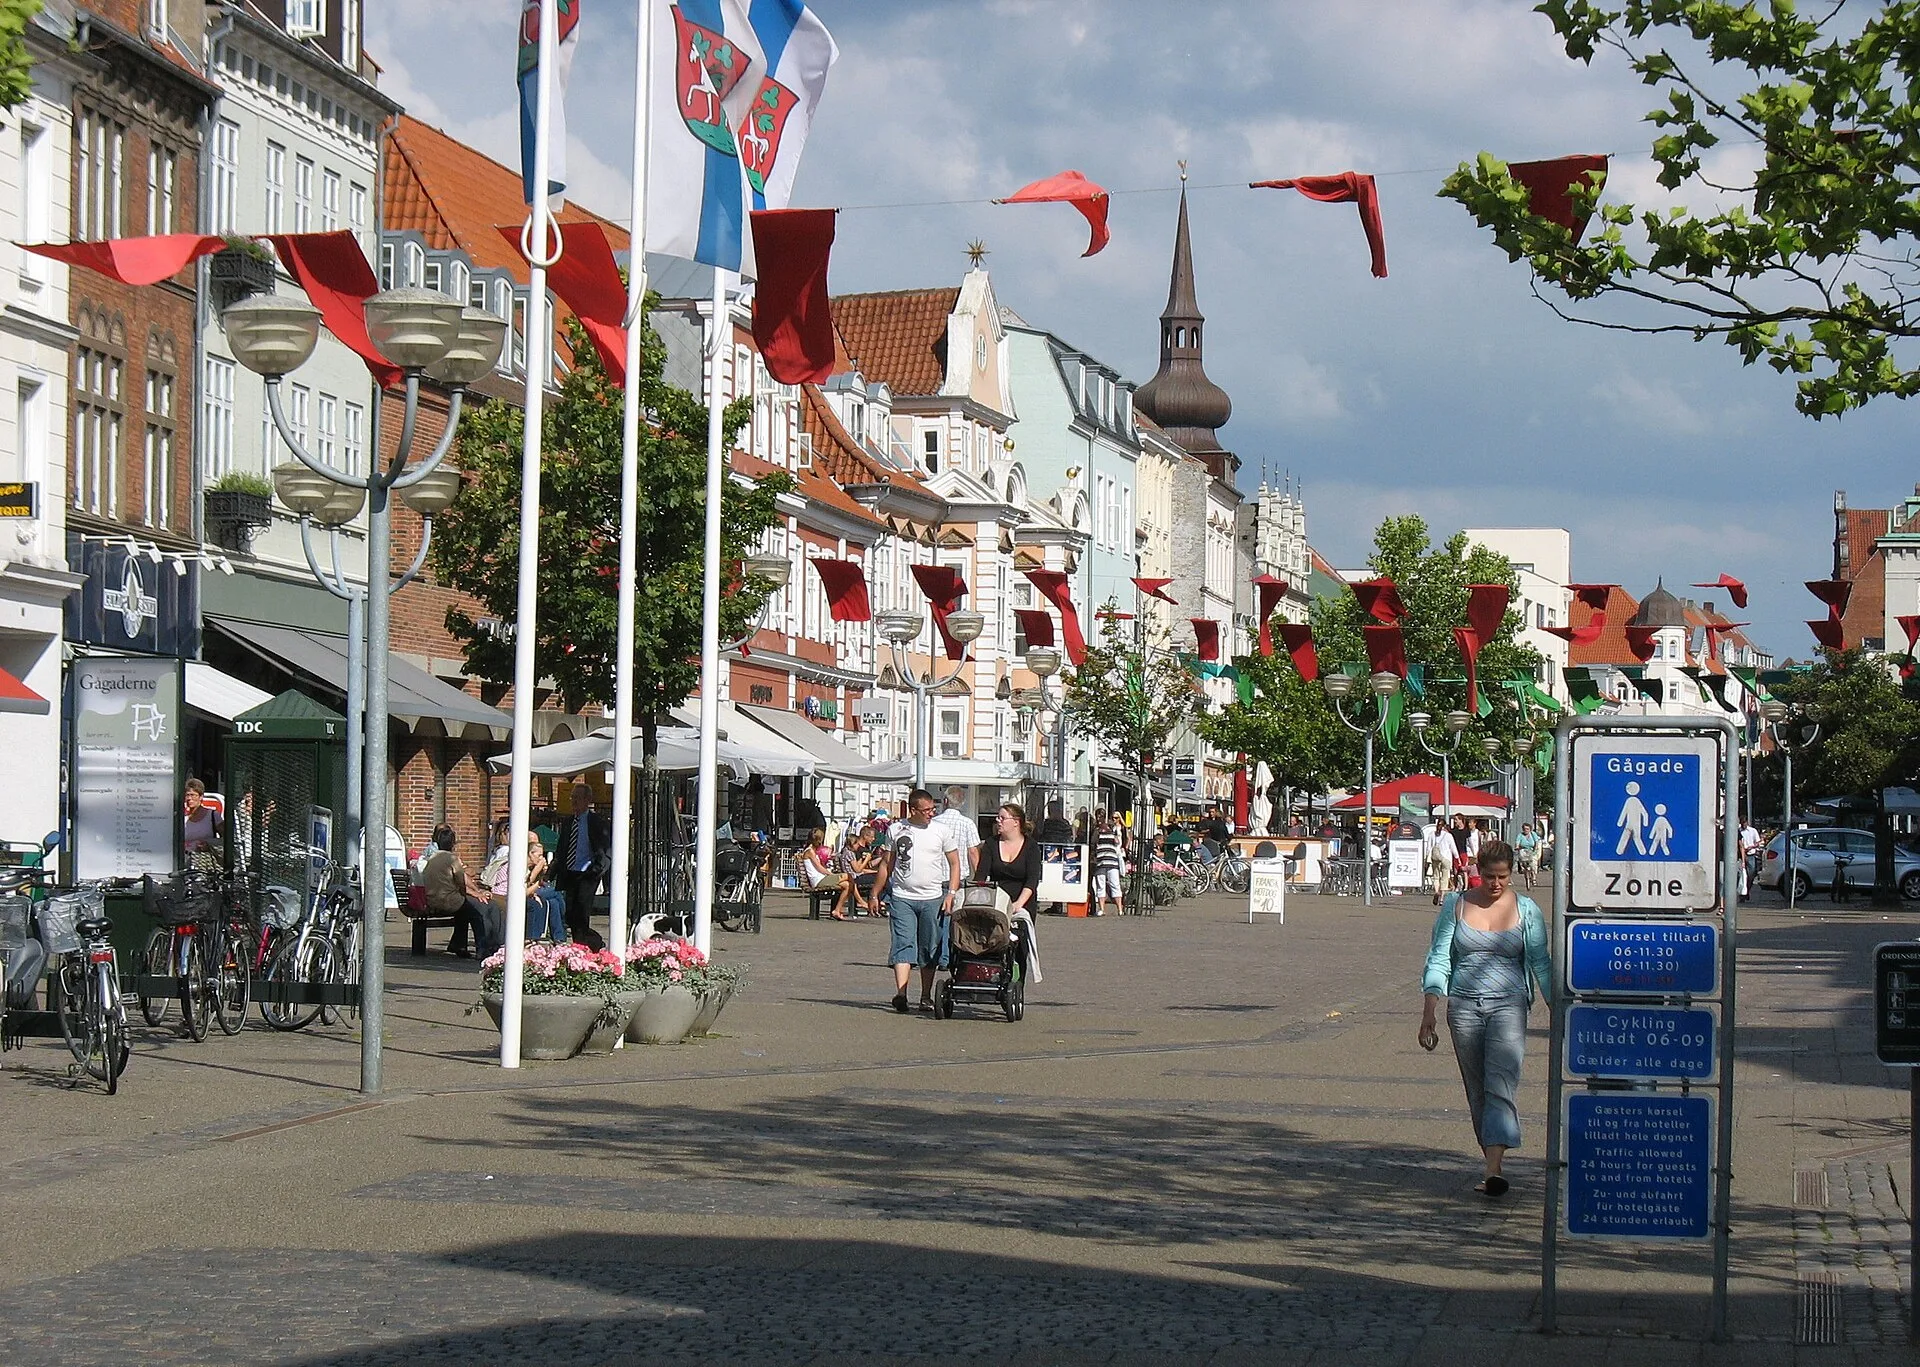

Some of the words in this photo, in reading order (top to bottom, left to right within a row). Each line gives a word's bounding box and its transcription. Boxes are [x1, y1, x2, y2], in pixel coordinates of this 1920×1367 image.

[80, 674, 157, 694] Gågaderne
[235, 722, 263, 733] TDC
[1608, 758, 1684, 775] Gågade
[1604, 873, 1683, 896] Zone
[1581, 930, 1656, 942] Varekørsel
[1663, 932, 1707, 942] tilladt
[1613, 946, 1674, 957] 06-11.30
[1608, 960, 1680, 972] (06-11.30)
[1607, 1015, 1676, 1032] Cykling
[1577, 1031, 1636, 1045] tilladt
[1646, 1033, 1705, 1046] 06-09
[1576, 1054, 1627, 1066] Gælder
[1635, 1057, 1662, 1068] alle
[1670, 1058, 1704, 1071] dage
[1595, 1105, 1643, 1115] Gæsters
[1647, 1107, 1684, 1116] kørsel
[1588, 1118, 1601, 1127] til
[1605, 1120, 1619, 1129] og
[1623, 1119, 1640, 1128] fra
[1644, 1119, 1691, 1129] hoteller
[1584, 1131, 1620, 1140] tilladt
[1624, 1132, 1649, 1141] hele
[1653, 1132, 1694, 1143] døgnet
[1595, 1147, 1634, 1157] Traffic
[1638, 1148, 1684, 1158] allowed
[1581, 1159, 1596, 1169] 24
[1600, 1160, 1632, 1170] hours
[1636, 1161, 1654, 1170] for
[1657, 1162, 1697, 1172] guests
[1585, 1173, 1596, 1181] to
[1600, 1173, 1621, 1182] and
[1626, 1173, 1652, 1183] from
[1656, 1174, 1693, 1184] hotels
[1593, 1189, 1612, 1198] Zu-
[1616, 1190, 1637, 1199] und
[1641, 1190, 1684, 1200] abfahrt
[1596, 1202, 1613, 1211] für
[1617, 1202, 1681, 1213] hotelgäste
[1583, 1214, 1597, 1223] 24
[1602, 1215, 1648, 1225] stunden
[1652, 1216, 1695, 1226] erlaubt
